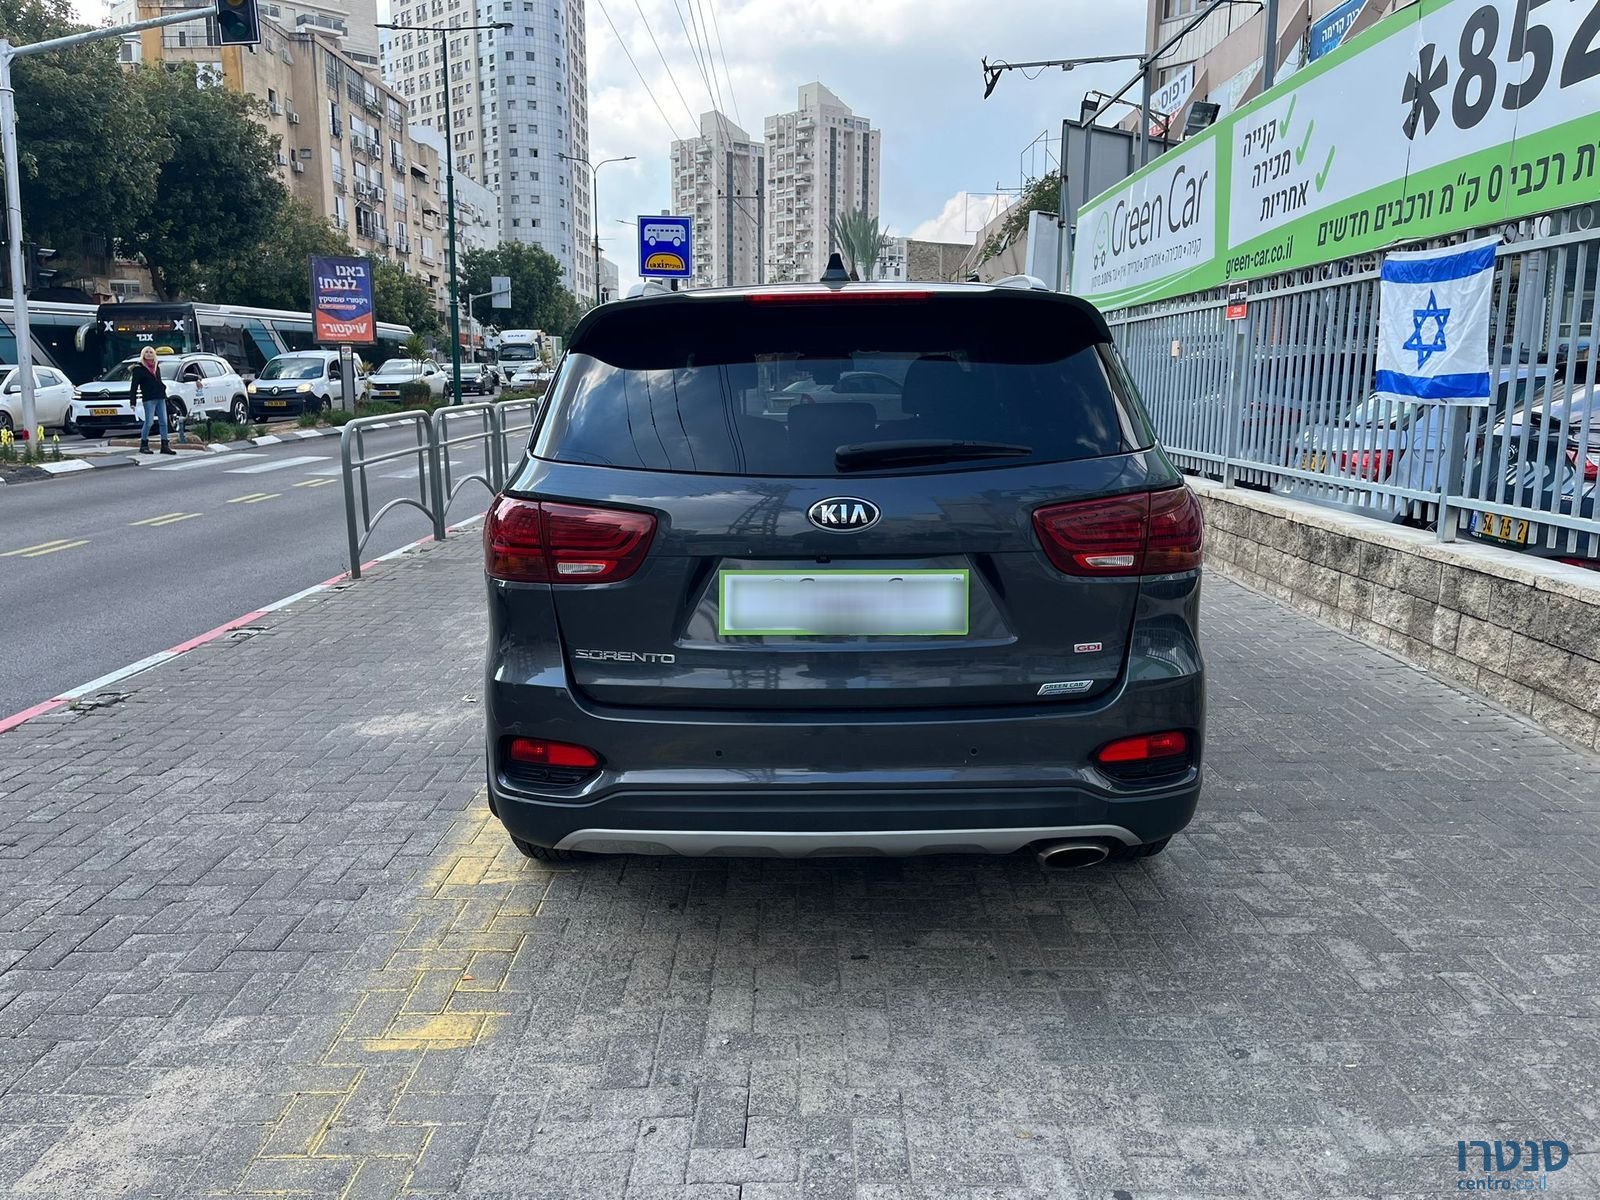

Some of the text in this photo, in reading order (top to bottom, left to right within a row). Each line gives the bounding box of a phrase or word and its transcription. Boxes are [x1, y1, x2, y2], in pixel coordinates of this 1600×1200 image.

[1161, 74, 1187, 109] דפוס
[1243, 119, 1277, 157] קנייה
[1252, 149, 1291, 189] מכירה
[1487, 164, 1502, 203] 0
[1511, 152, 1565, 196] רכבי
[1111, 164, 1209, 257] Green Car
[1260, 179, 1310, 222] אחריות
[1374, 190, 1434, 232] ורכבים
[1317, 209, 1369, 247] חדשים
[336, 265, 365, 277] באנו
[1225, 236, 1293, 279] green-car.co.il
[318, 276, 357, 290] לנצח!
[136, 333, 154, 342] אגד
[820, 503, 869, 524] KIA
[575, 648, 676, 664] SORENTO
[1076, 643, 1101, 652] GDI
